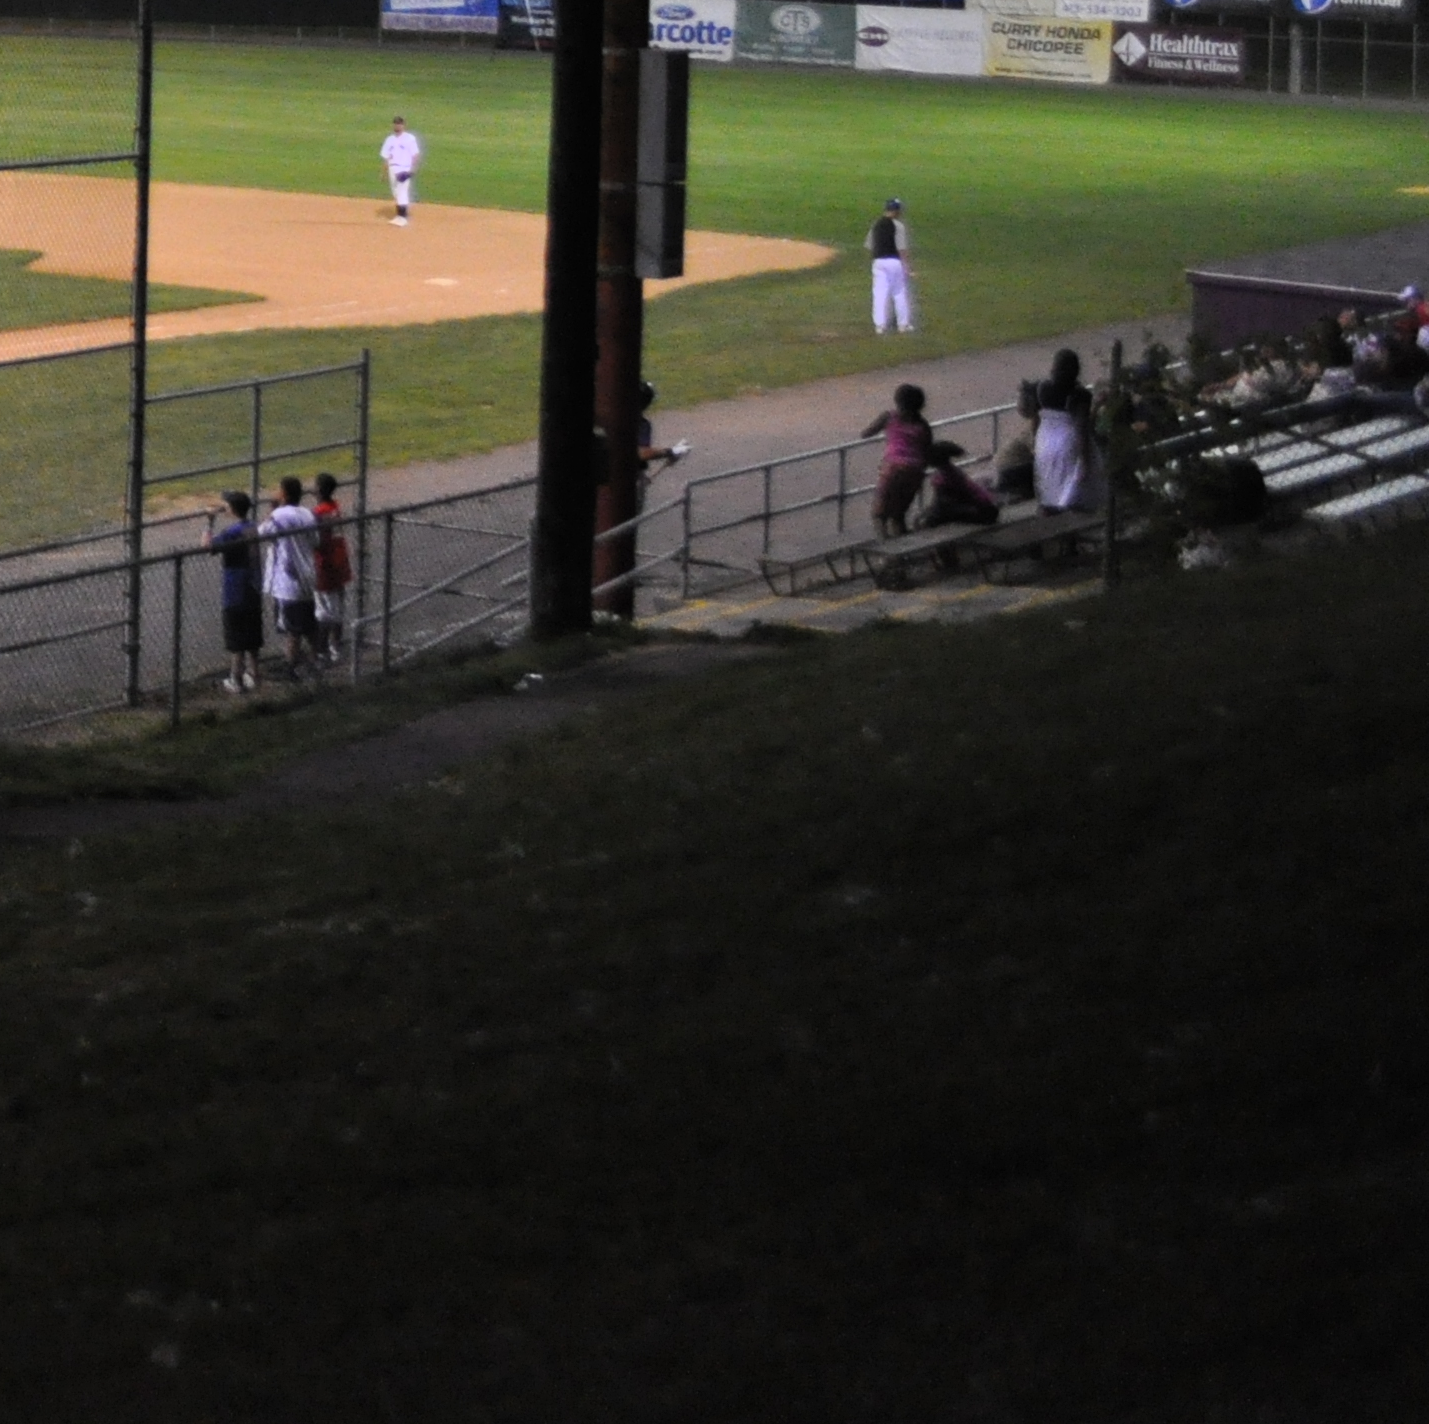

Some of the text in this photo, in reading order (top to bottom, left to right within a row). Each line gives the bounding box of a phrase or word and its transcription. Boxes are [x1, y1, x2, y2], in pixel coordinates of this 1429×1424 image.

[992, 22, 1041, 36] CURRY
[1045, 25, 1101, 40] HONDA
[1007, 38, 1084, 55] CHICOPEE
[1149, 33, 1238, 57] Healthtrax
[1148, 56, 1183, 70] Fitness
[1194, 59, 1239, 74] Wellness
